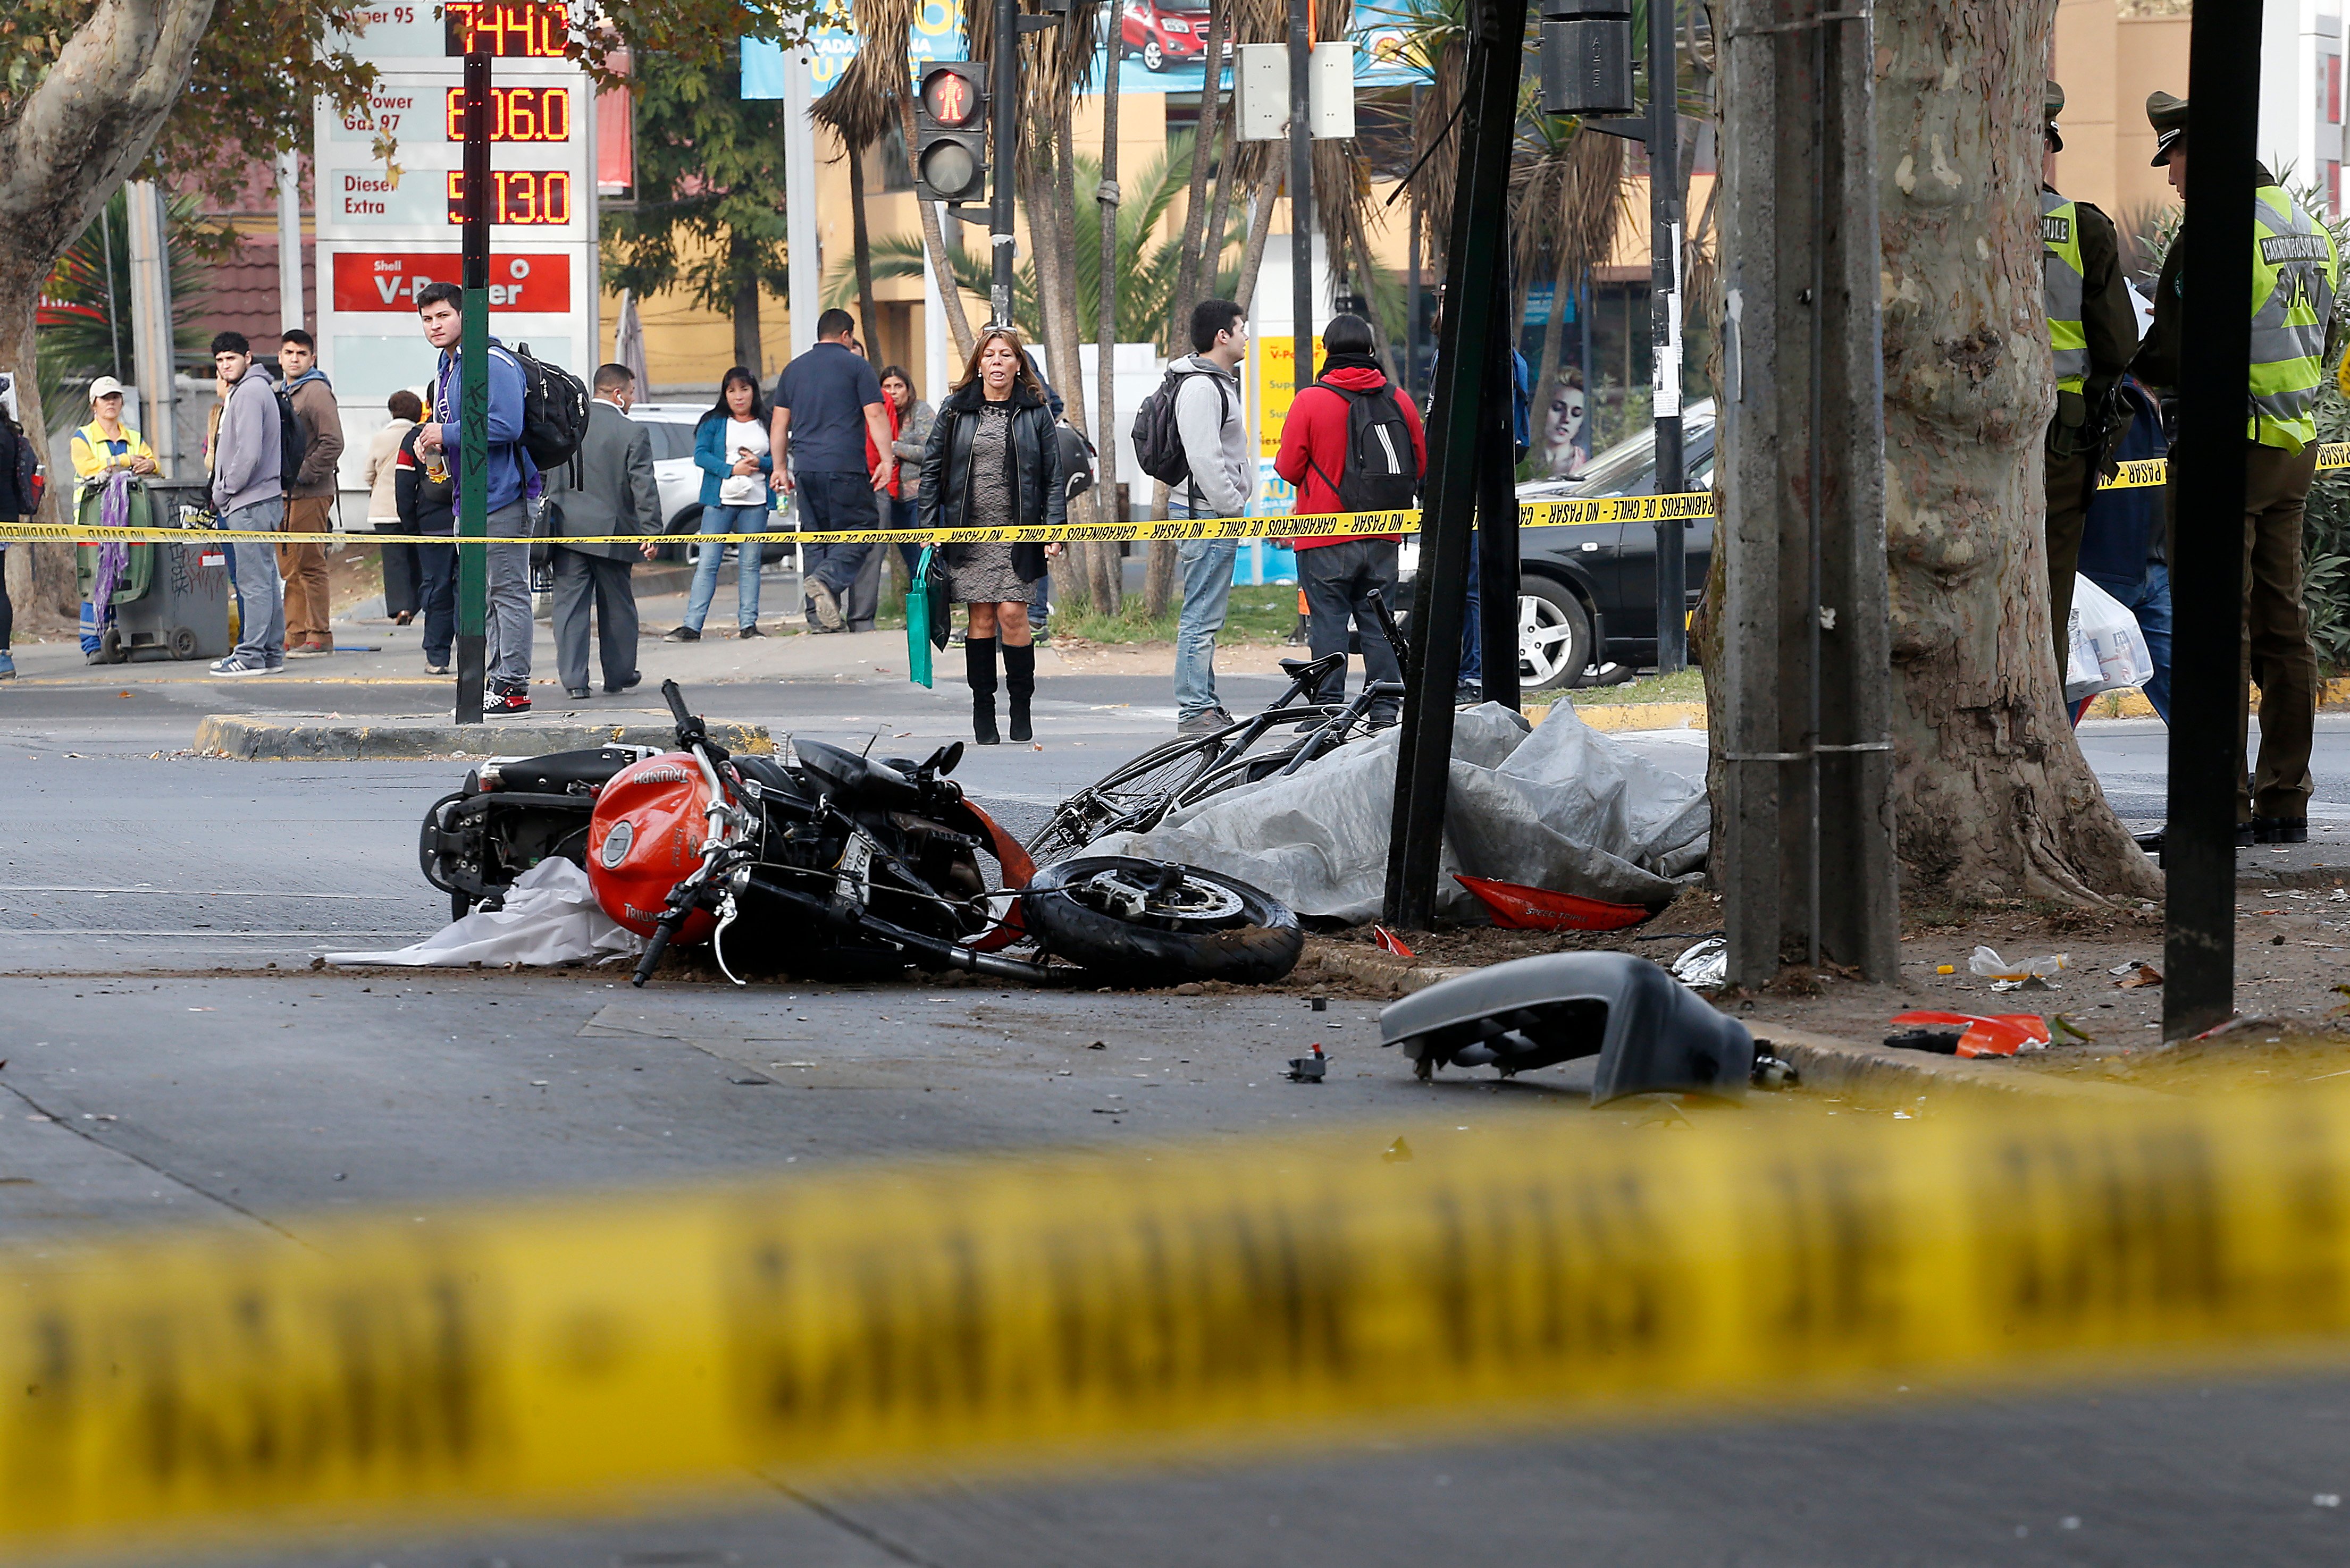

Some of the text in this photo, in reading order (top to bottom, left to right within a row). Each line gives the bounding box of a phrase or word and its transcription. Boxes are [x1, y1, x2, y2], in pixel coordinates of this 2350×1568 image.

[394, 7, 414, 23] 95
[344, 114, 400, 131] Gas 97
[345, 197, 385, 214] Extra
[448, 171, 570, 224] 513.0
[2041, 218, 2067, 240] HILE
[373, 260, 402, 272] Shell
[373, 276, 523, 305] V-Per
[2277, 267, 2328, 309] SAT
[2127, 462, 2161, 484] PASAR
[1548, 502, 1583, 524] PASAR
[1582, 501, 1600, 521] NO
[1610, 501, 1640, 520] CHILE
[1642, 499, 1656, 518] DE
[1660, 494, 1714, 518] RABINEROS
[1150, 523, 1189, 539] PASAR
[1188, 522, 1205, 538] NO
[1214, 521, 1247, 537] CHILE
[1246, 520, 1264, 536] DE
[1265, 517, 1337, 536] CARABINEROS
[1350, 514, 1388, 533] PASAR
[1387, 513, 1404, 533] NO
[946, 530, 987, 543] PASAR
[986, 530, 1004, 542] NO
[1015, 528, 1046, 542] CHILE
[1048, 528, 1062, 541] DE
[1063, 526, 1137, 541] CARABINEROS
[634, 769, 689, 785] TRIUMPH
[1525, 907, 1556, 918] SPEED
